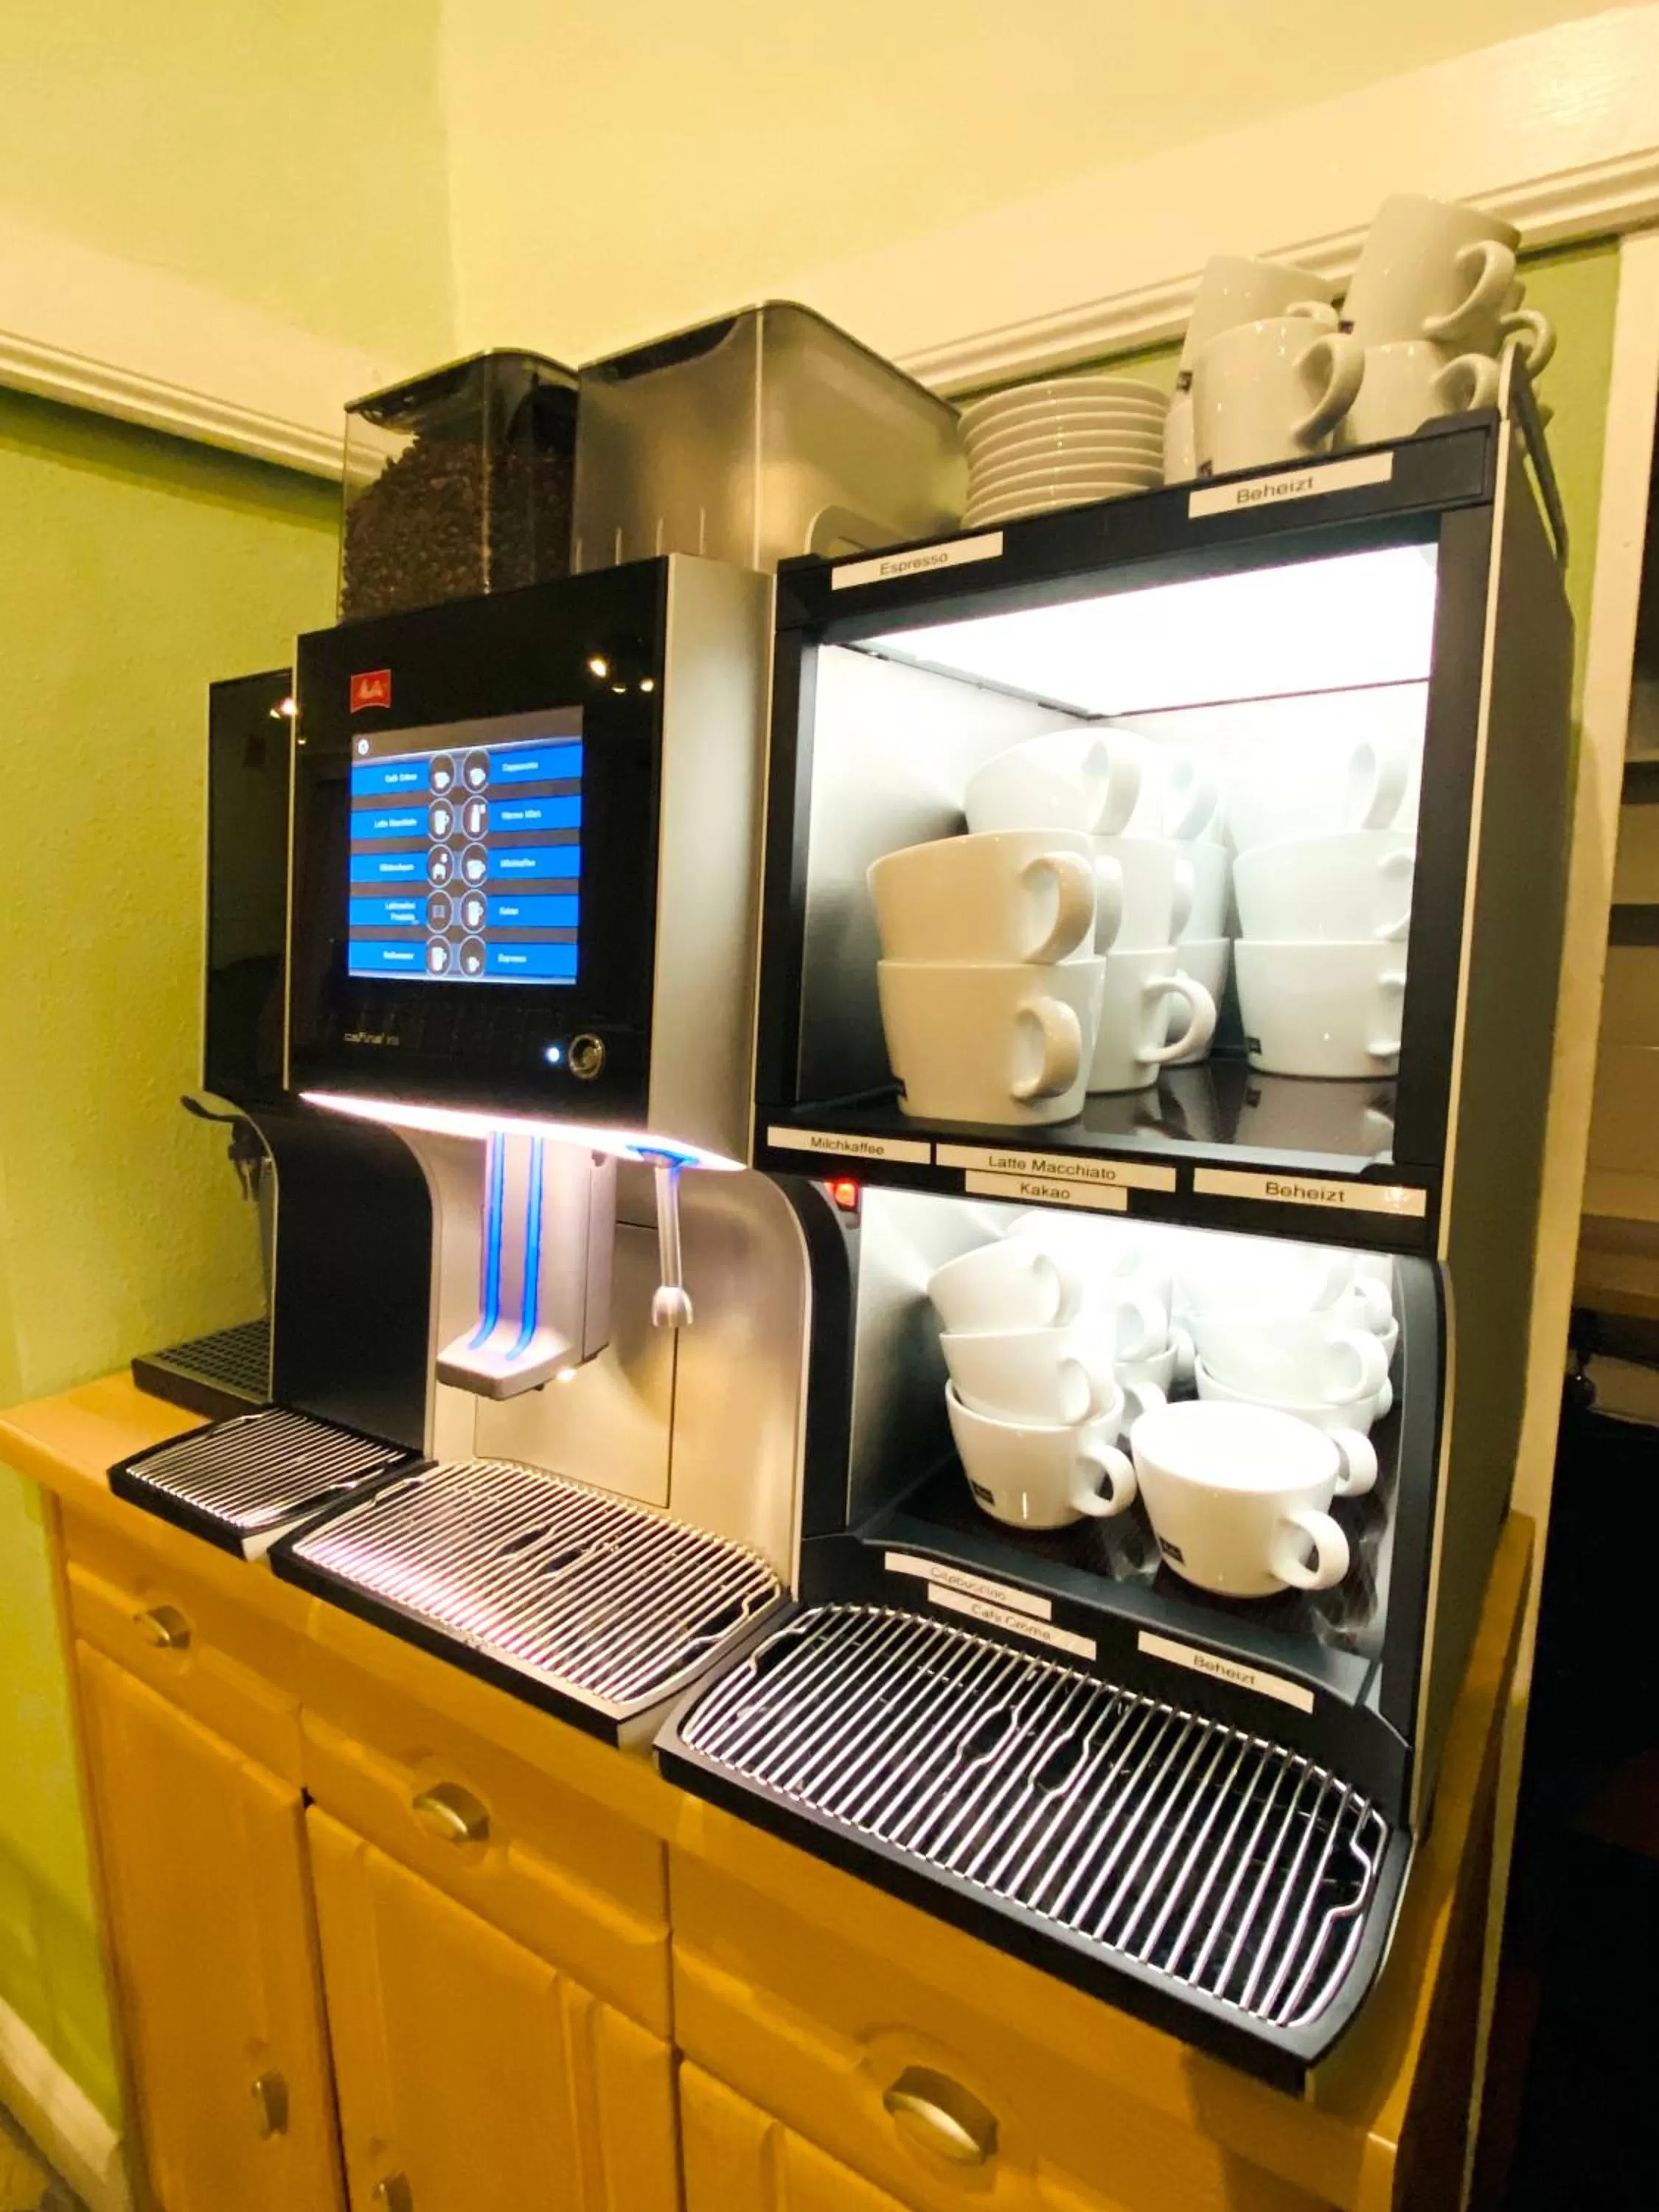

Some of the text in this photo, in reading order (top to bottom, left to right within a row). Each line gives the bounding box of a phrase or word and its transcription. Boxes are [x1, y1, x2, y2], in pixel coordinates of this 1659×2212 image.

[1237, 476, 1313, 504] Beheizt
[880, 552, 948, 575] Espresso
[810, 1136, 885, 1155] Milchkaffee
[988, 1155, 1116, 1180] Latte Macchiato
[1020, 1182, 1071, 1200] Kakao
[1265, 1181, 1345, 1203] Beheizt
[1194, 1654, 1256, 1685] Beheizt
